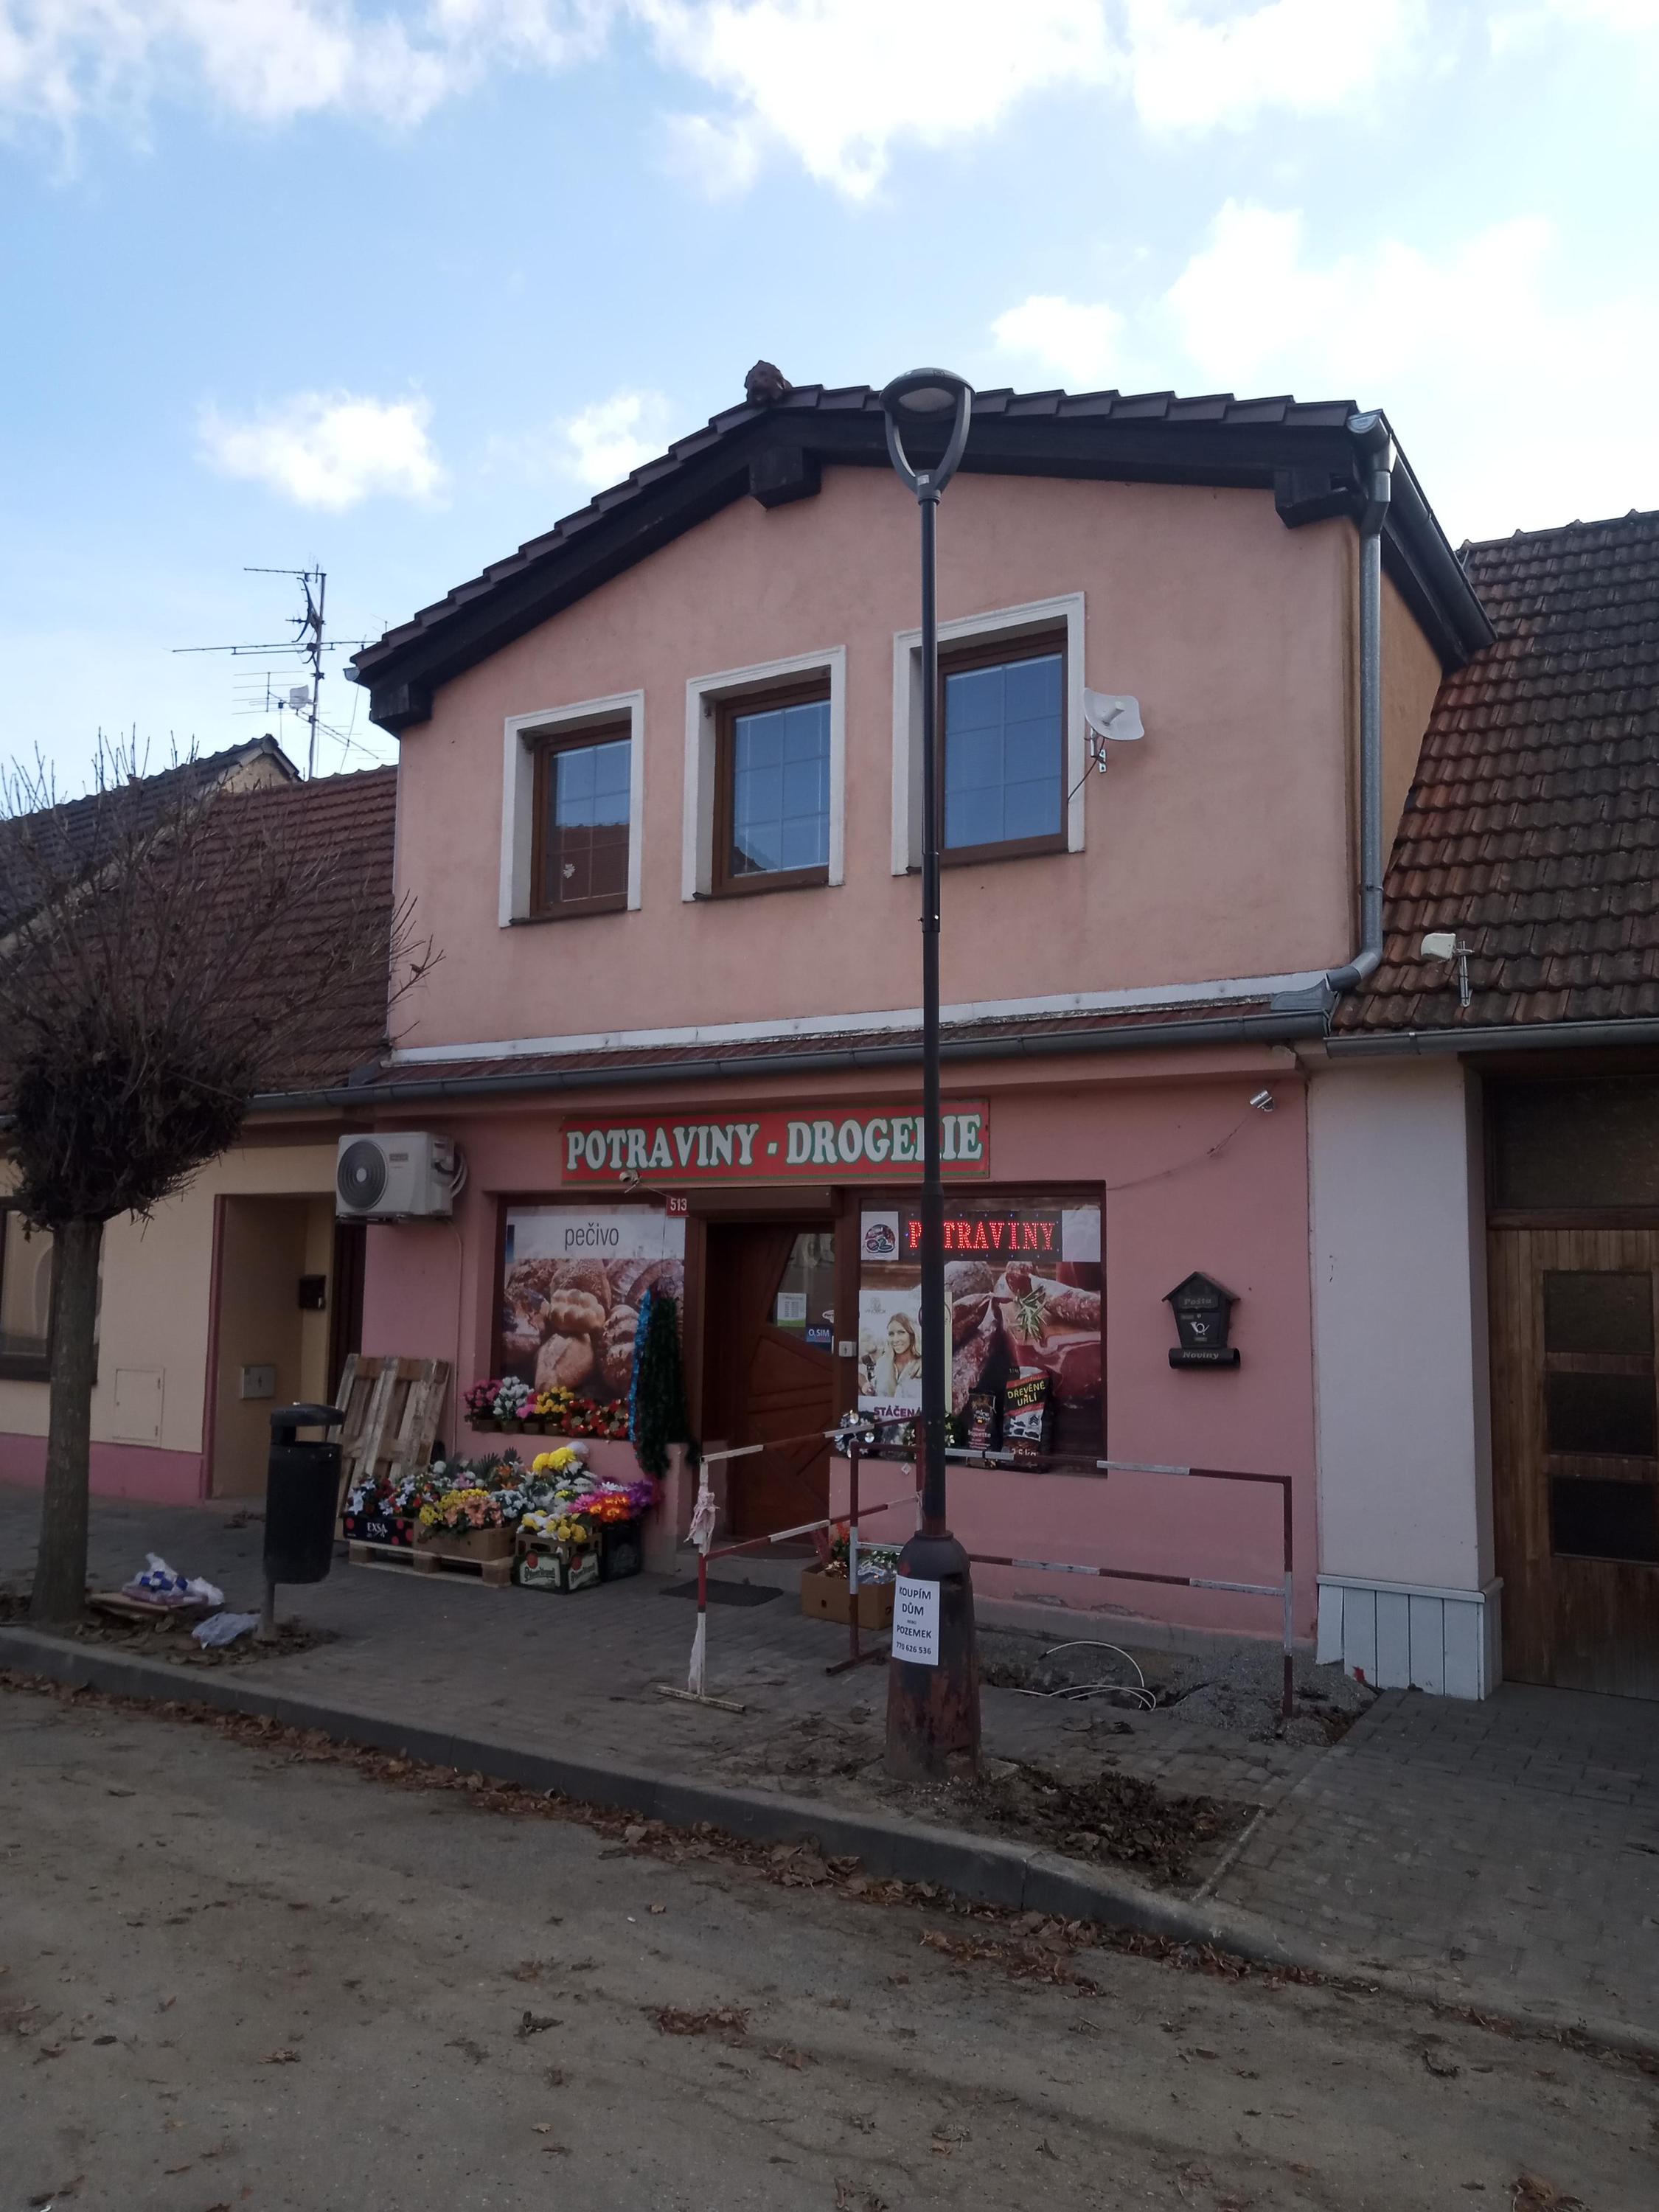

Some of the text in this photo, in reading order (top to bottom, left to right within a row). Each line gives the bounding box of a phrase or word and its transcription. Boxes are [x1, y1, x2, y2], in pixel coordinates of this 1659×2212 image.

[566, 1123, 759, 1170] POTRAVINY
[669, 1198, 688, 1211] 513
[565, 1222, 619, 1251] pečivo
[908, 1221, 1055, 1251] PTRAVINY
[816, 1329, 830, 1338] SIM
[1183, 1350, 1220, 1360] Noviny
[1007, 1380, 1046, 1399] DŘEVĚNÉ
[1017, 1392, 1038, 1407] UHLÍ
[899, 1587, 931, 1600] KOUPÍM
[902, 1602, 924, 1615] DŮM
[897, 1625, 932, 1638] POZEMEK
[905, 1644, 917, 1653] 626
[919, 1646, 932, 1655] 536
